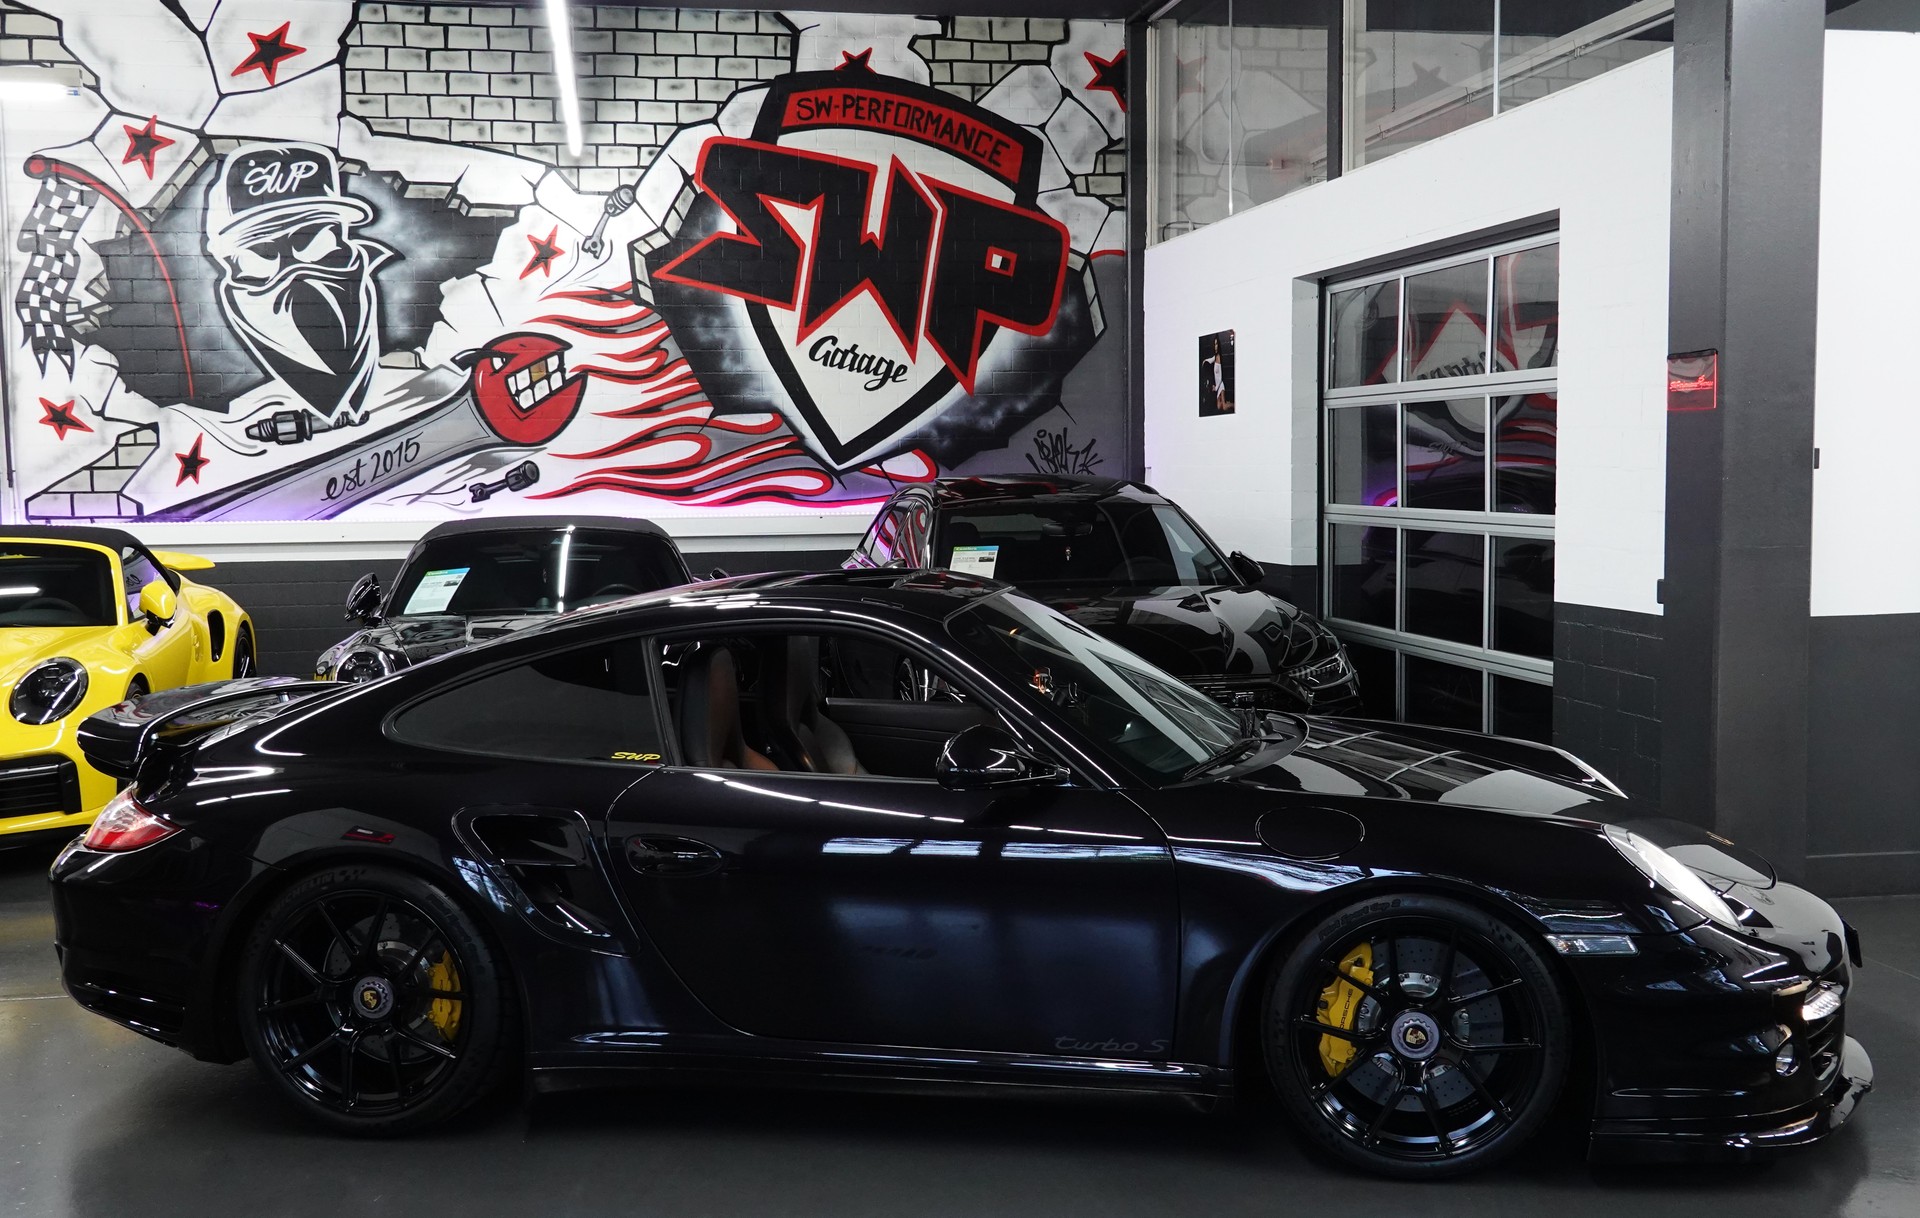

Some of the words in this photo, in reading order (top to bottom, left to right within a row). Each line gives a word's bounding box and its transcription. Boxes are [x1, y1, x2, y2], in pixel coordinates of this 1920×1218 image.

[797, 94, 1010, 168] SW-PERFORMANCE
[244, 160, 319, 196] SWP
[653, 136, 1070, 397] SWP
[809, 335, 908, 392] Garage
[320, 458, 367, 501] est
[370, 431, 424, 483] 2015
[611, 751, 661, 762] SWP
[1055, 1035, 1140, 1052] turbo
[1143, 1039, 1170, 1053] S
